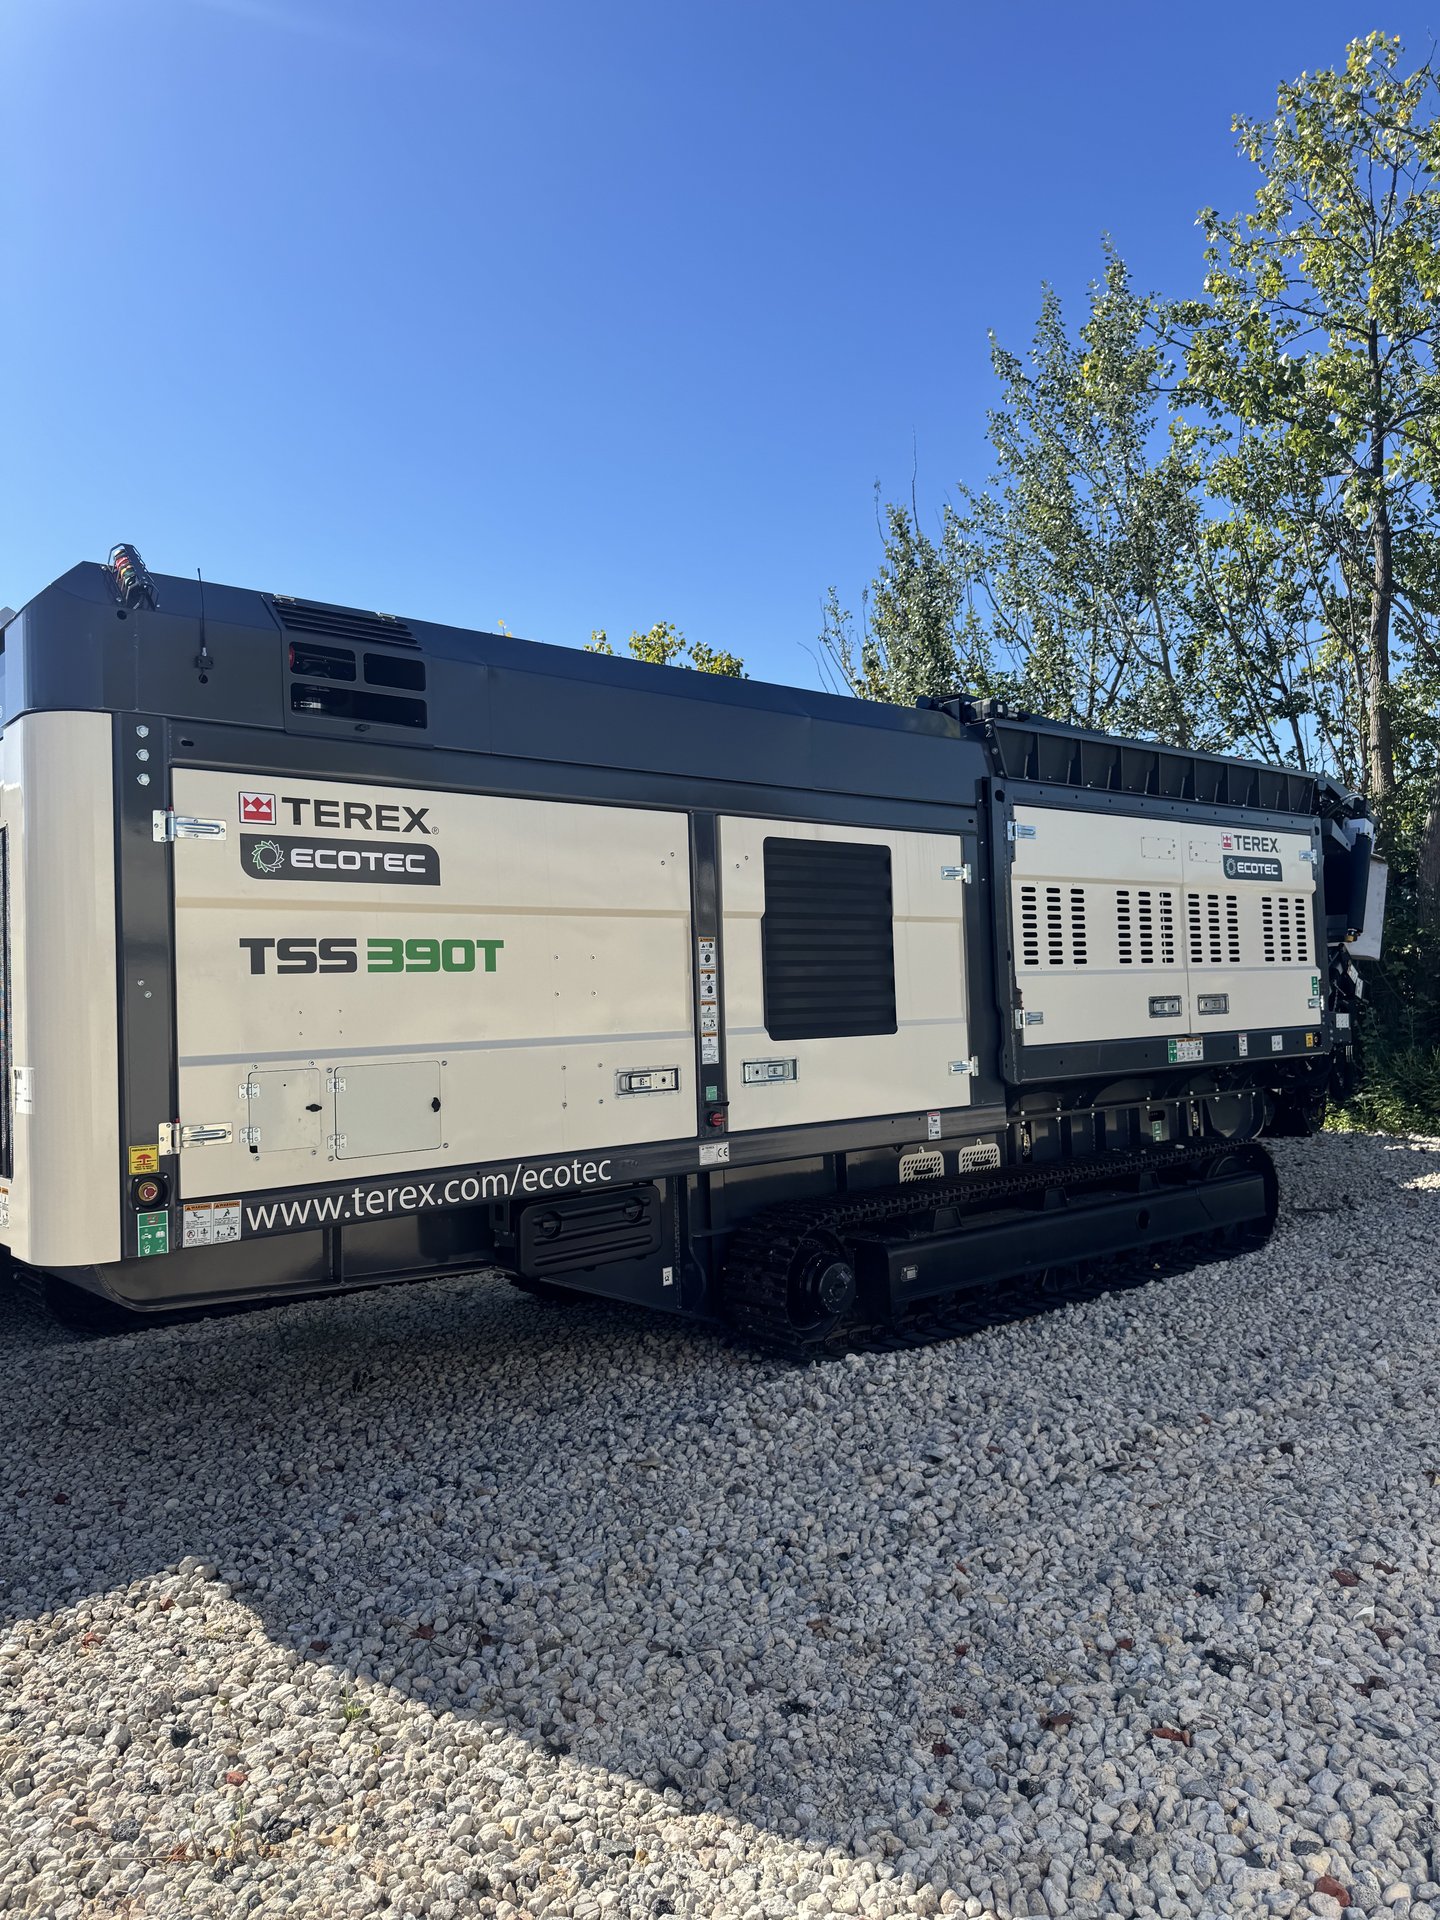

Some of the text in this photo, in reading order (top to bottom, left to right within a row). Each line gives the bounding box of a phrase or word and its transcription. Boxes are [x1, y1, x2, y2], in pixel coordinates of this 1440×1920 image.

[1233, 834, 1279, 853] TEREX
[290, 847, 426, 874] ECOTEC
[1237, 861, 1279, 875] ECOTEC
[239, 937, 505, 975] TSS 390T
[246, 1159, 612, 1231] www.terex.com/ecotec
